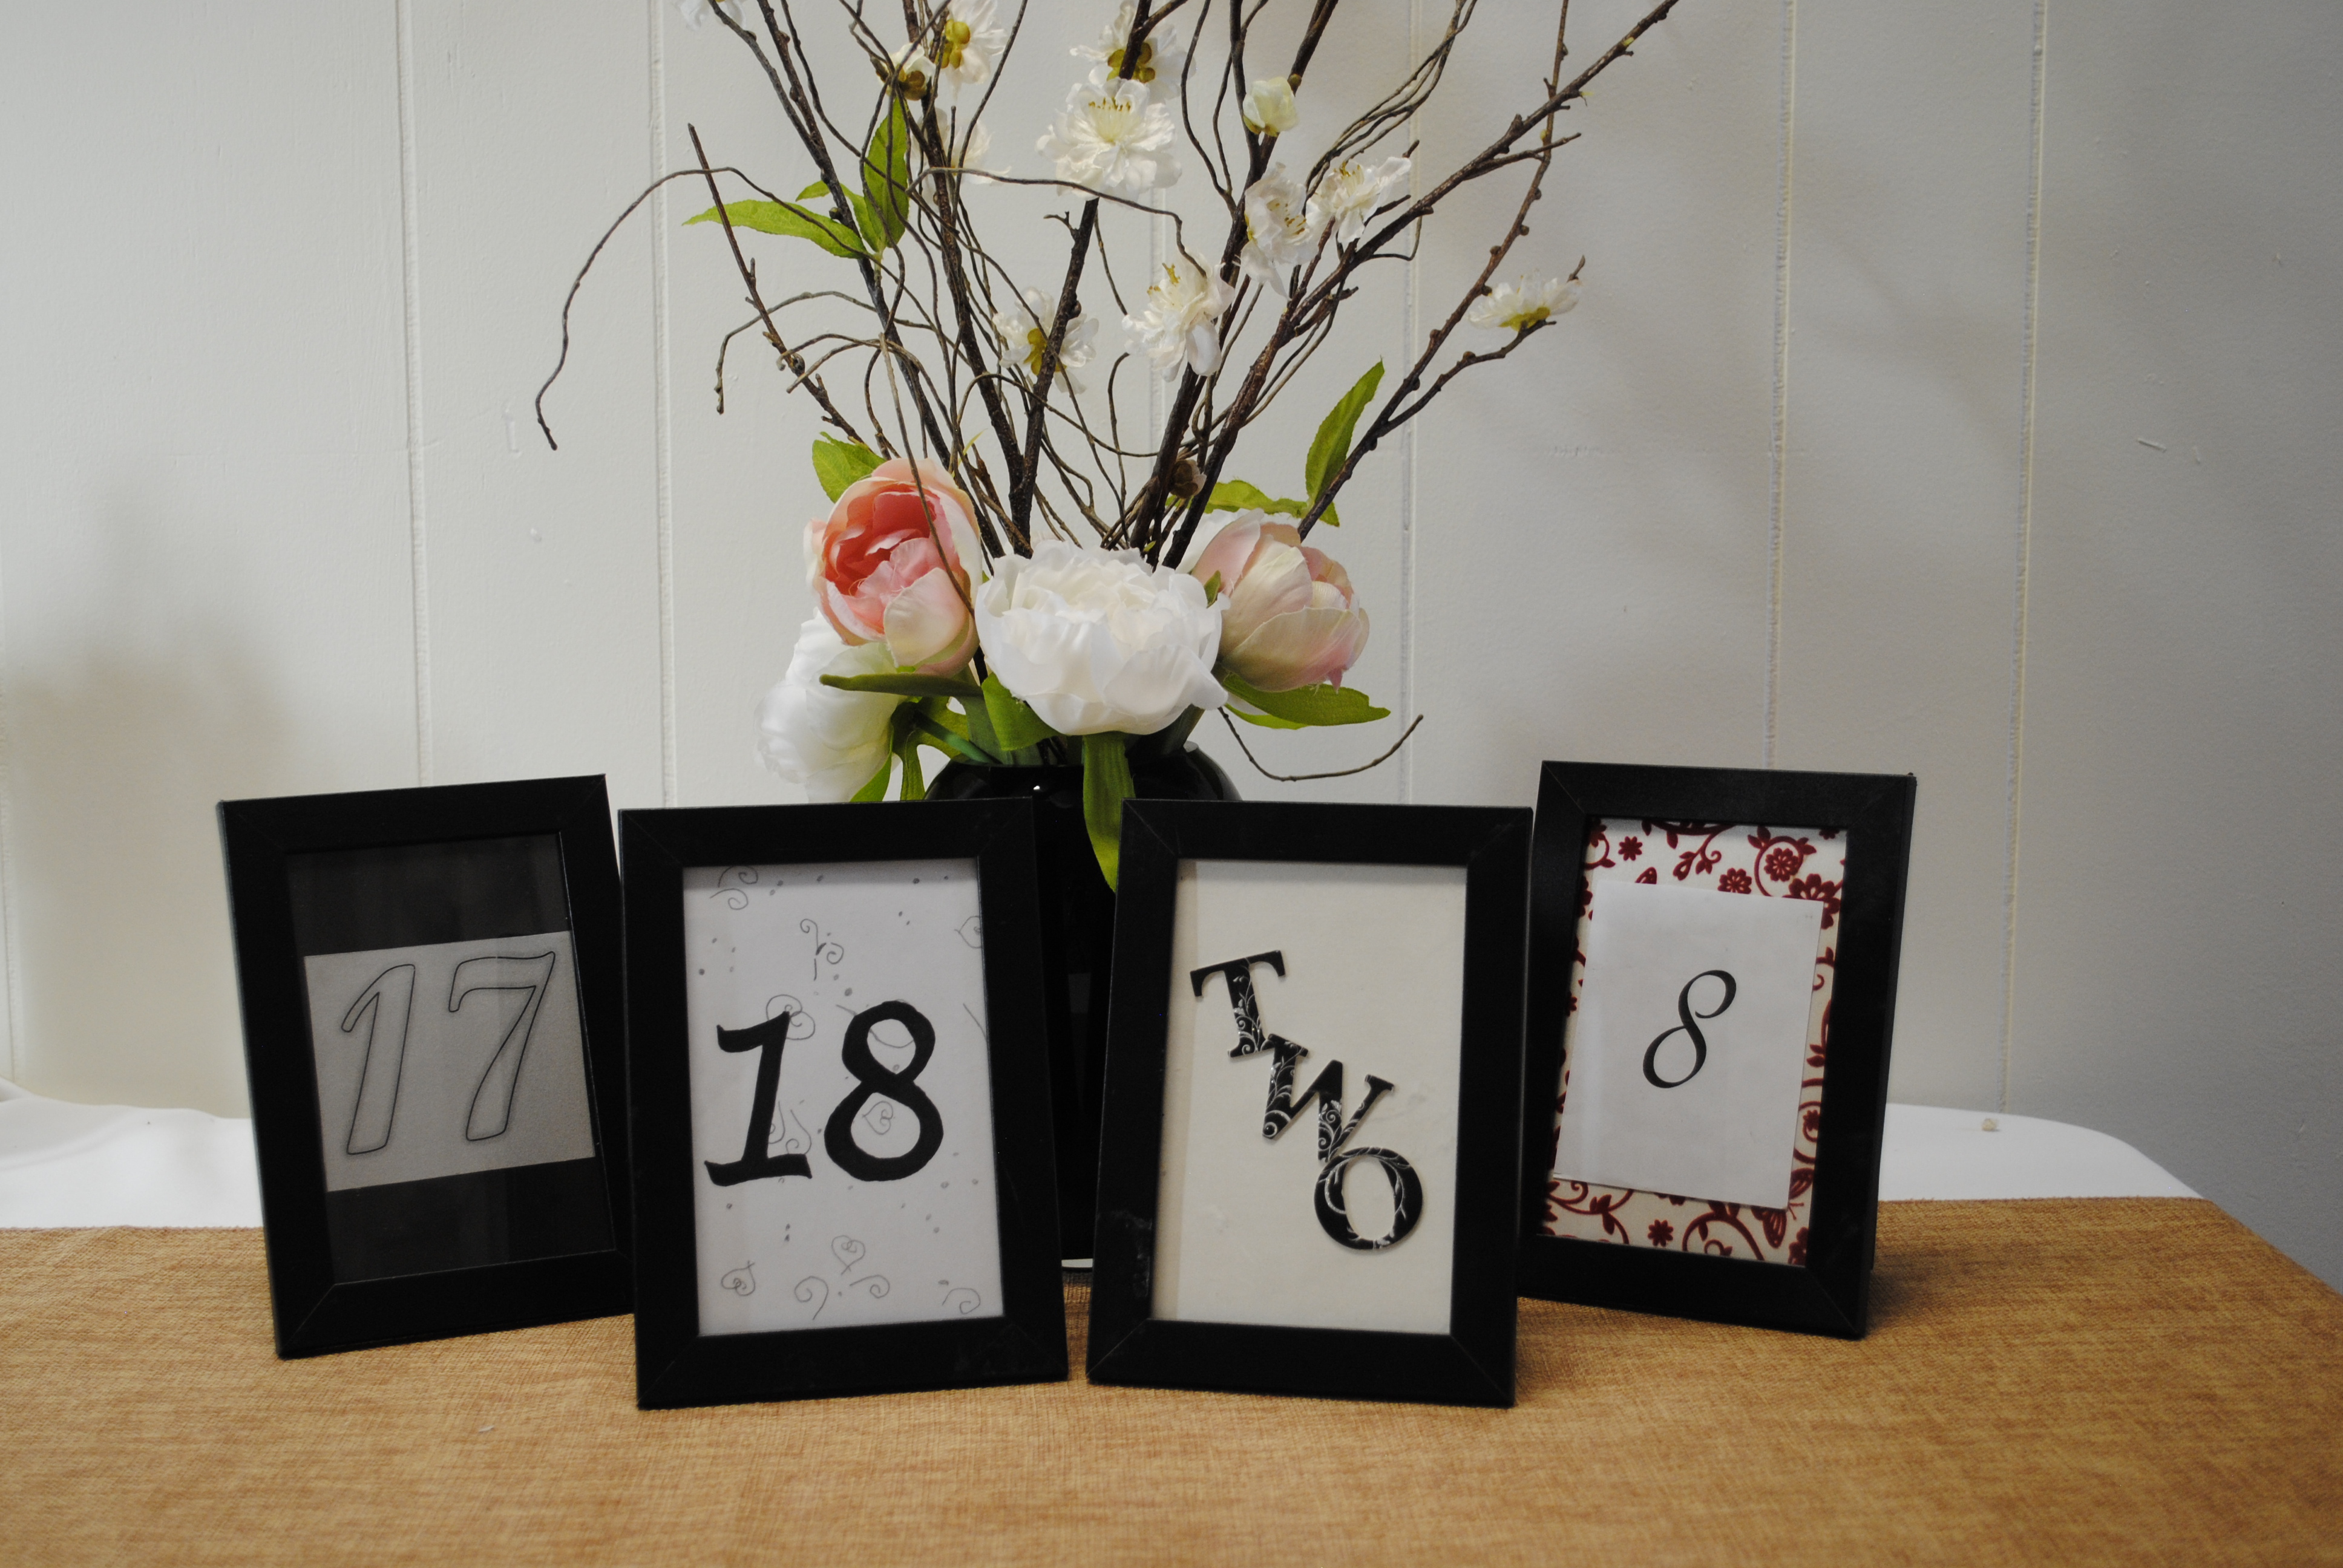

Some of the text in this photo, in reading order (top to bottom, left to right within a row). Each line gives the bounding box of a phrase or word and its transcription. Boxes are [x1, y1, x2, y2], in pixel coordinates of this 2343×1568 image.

[342, 950, 555, 1155] 17
[704, 1000, 944, 1186] 18
[1190, 950, 1423, 1251] TWO
[1642, 970, 1737, 1088] 8
